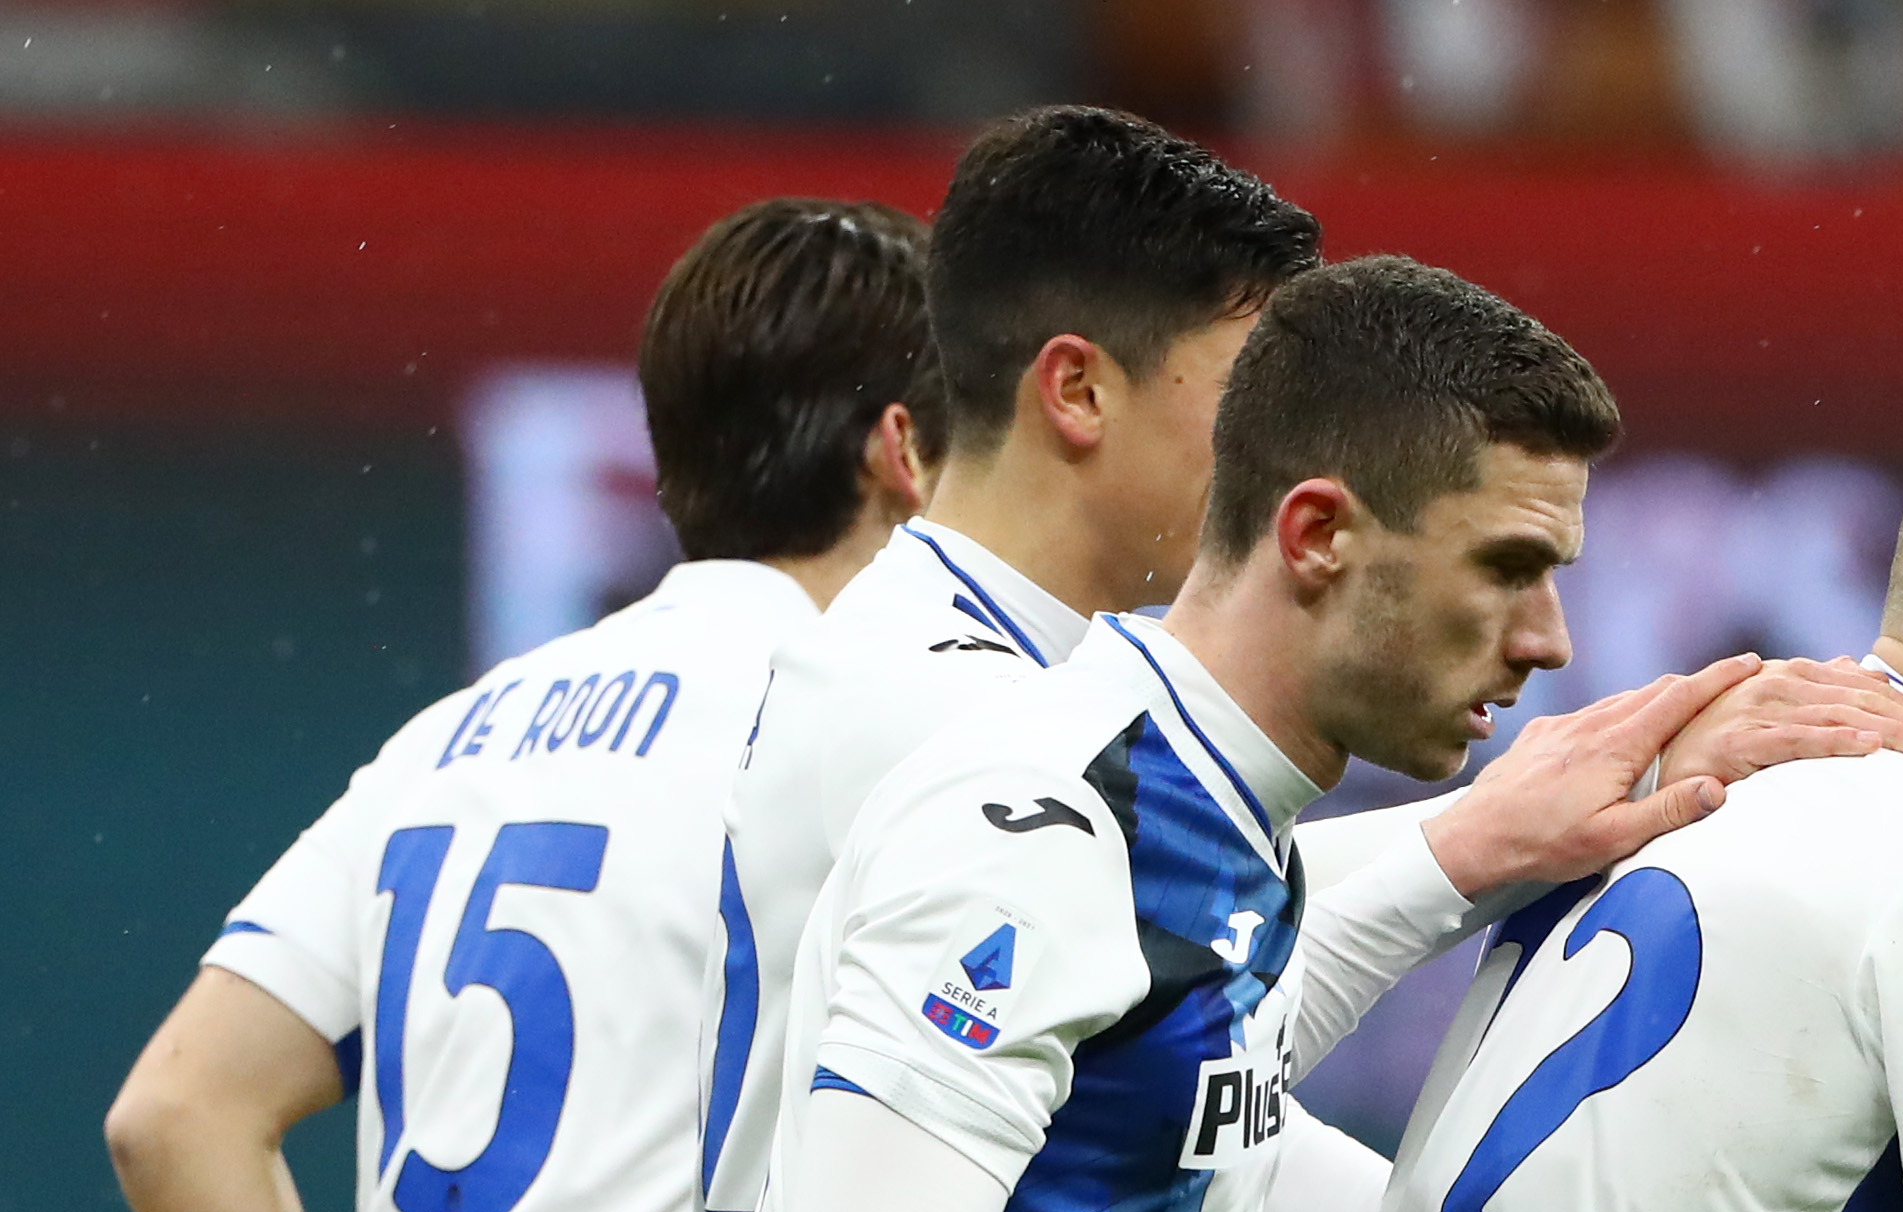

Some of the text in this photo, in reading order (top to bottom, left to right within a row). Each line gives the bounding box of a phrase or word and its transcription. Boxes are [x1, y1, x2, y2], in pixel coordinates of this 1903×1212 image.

[510, 669, 681, 762] ROON
[941, 982, 998, 1020] SERIE A
[952, 1013, 992, 1045] TIM
